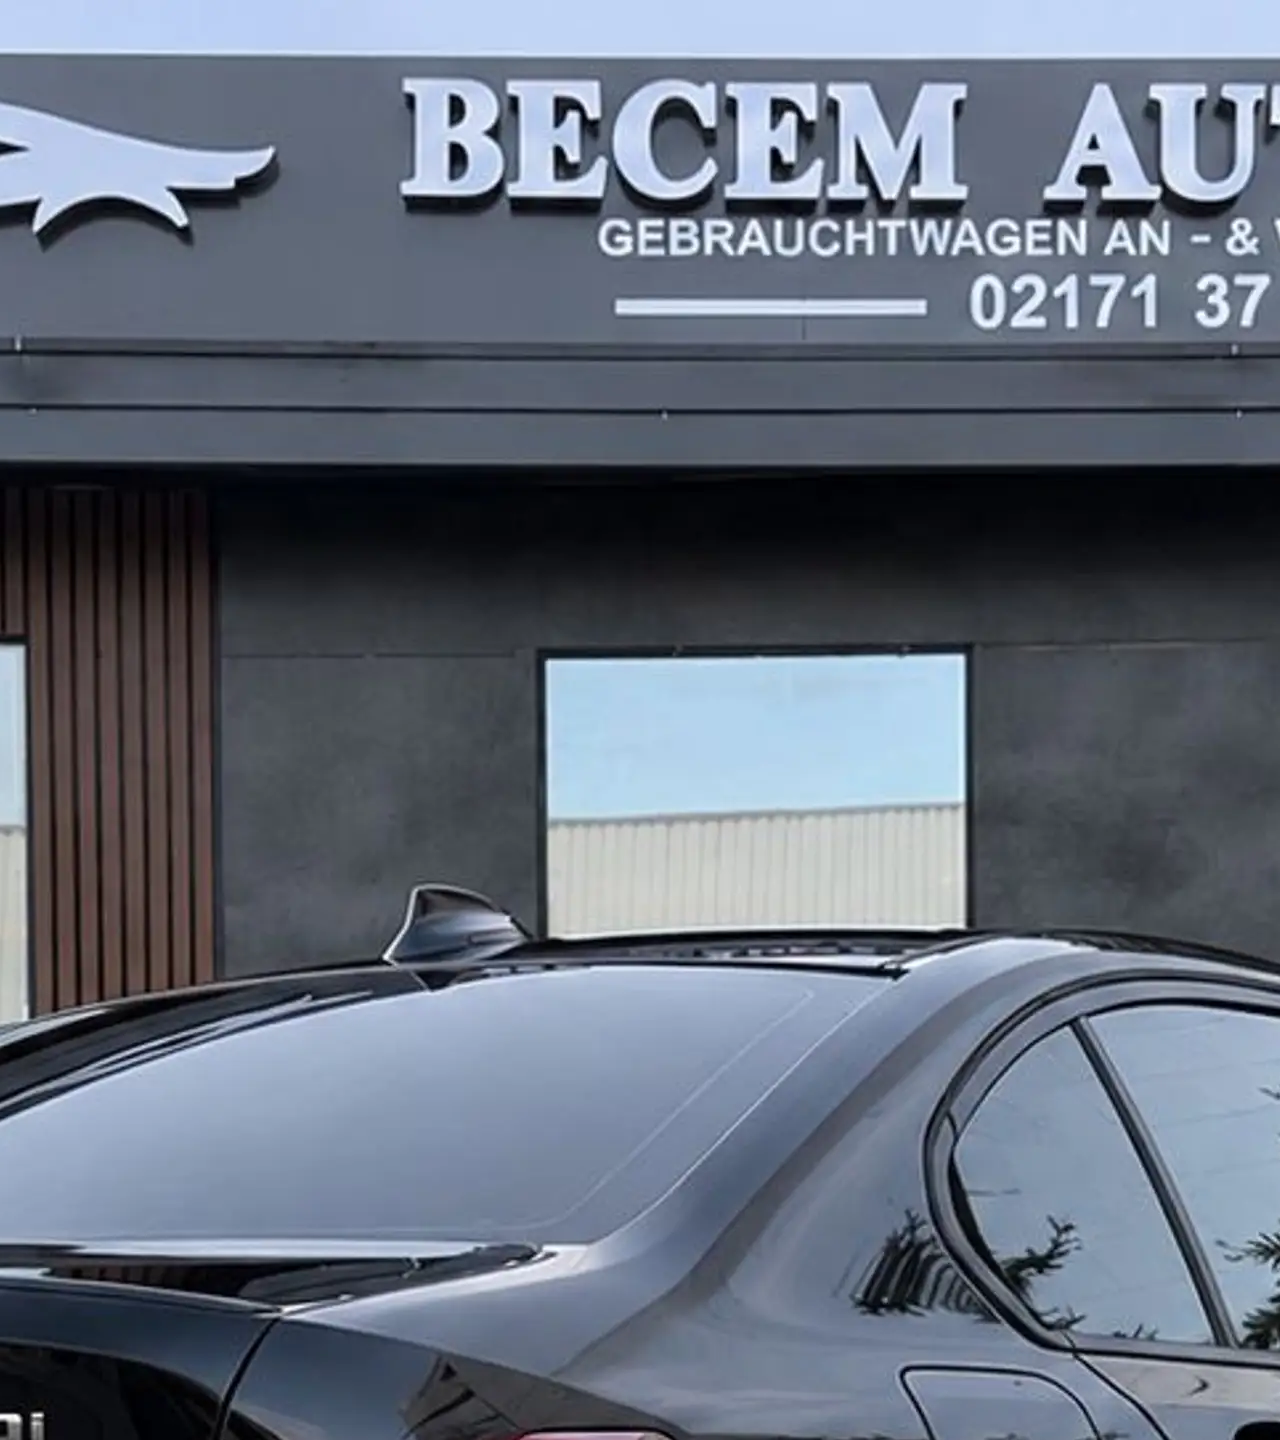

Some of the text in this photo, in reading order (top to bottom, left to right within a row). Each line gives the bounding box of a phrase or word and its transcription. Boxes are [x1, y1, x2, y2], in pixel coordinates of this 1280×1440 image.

[399, 77, 969, 201] BECEM
[598, 217, 1087, 257] GEBRAUCHTWAGEN
[1103, 218, 1171, 256] AN
[1225, 217, 1260, 257] &
[969, 273, 1158, 328] 02171
[1195, 273, 1272, 328] 37
